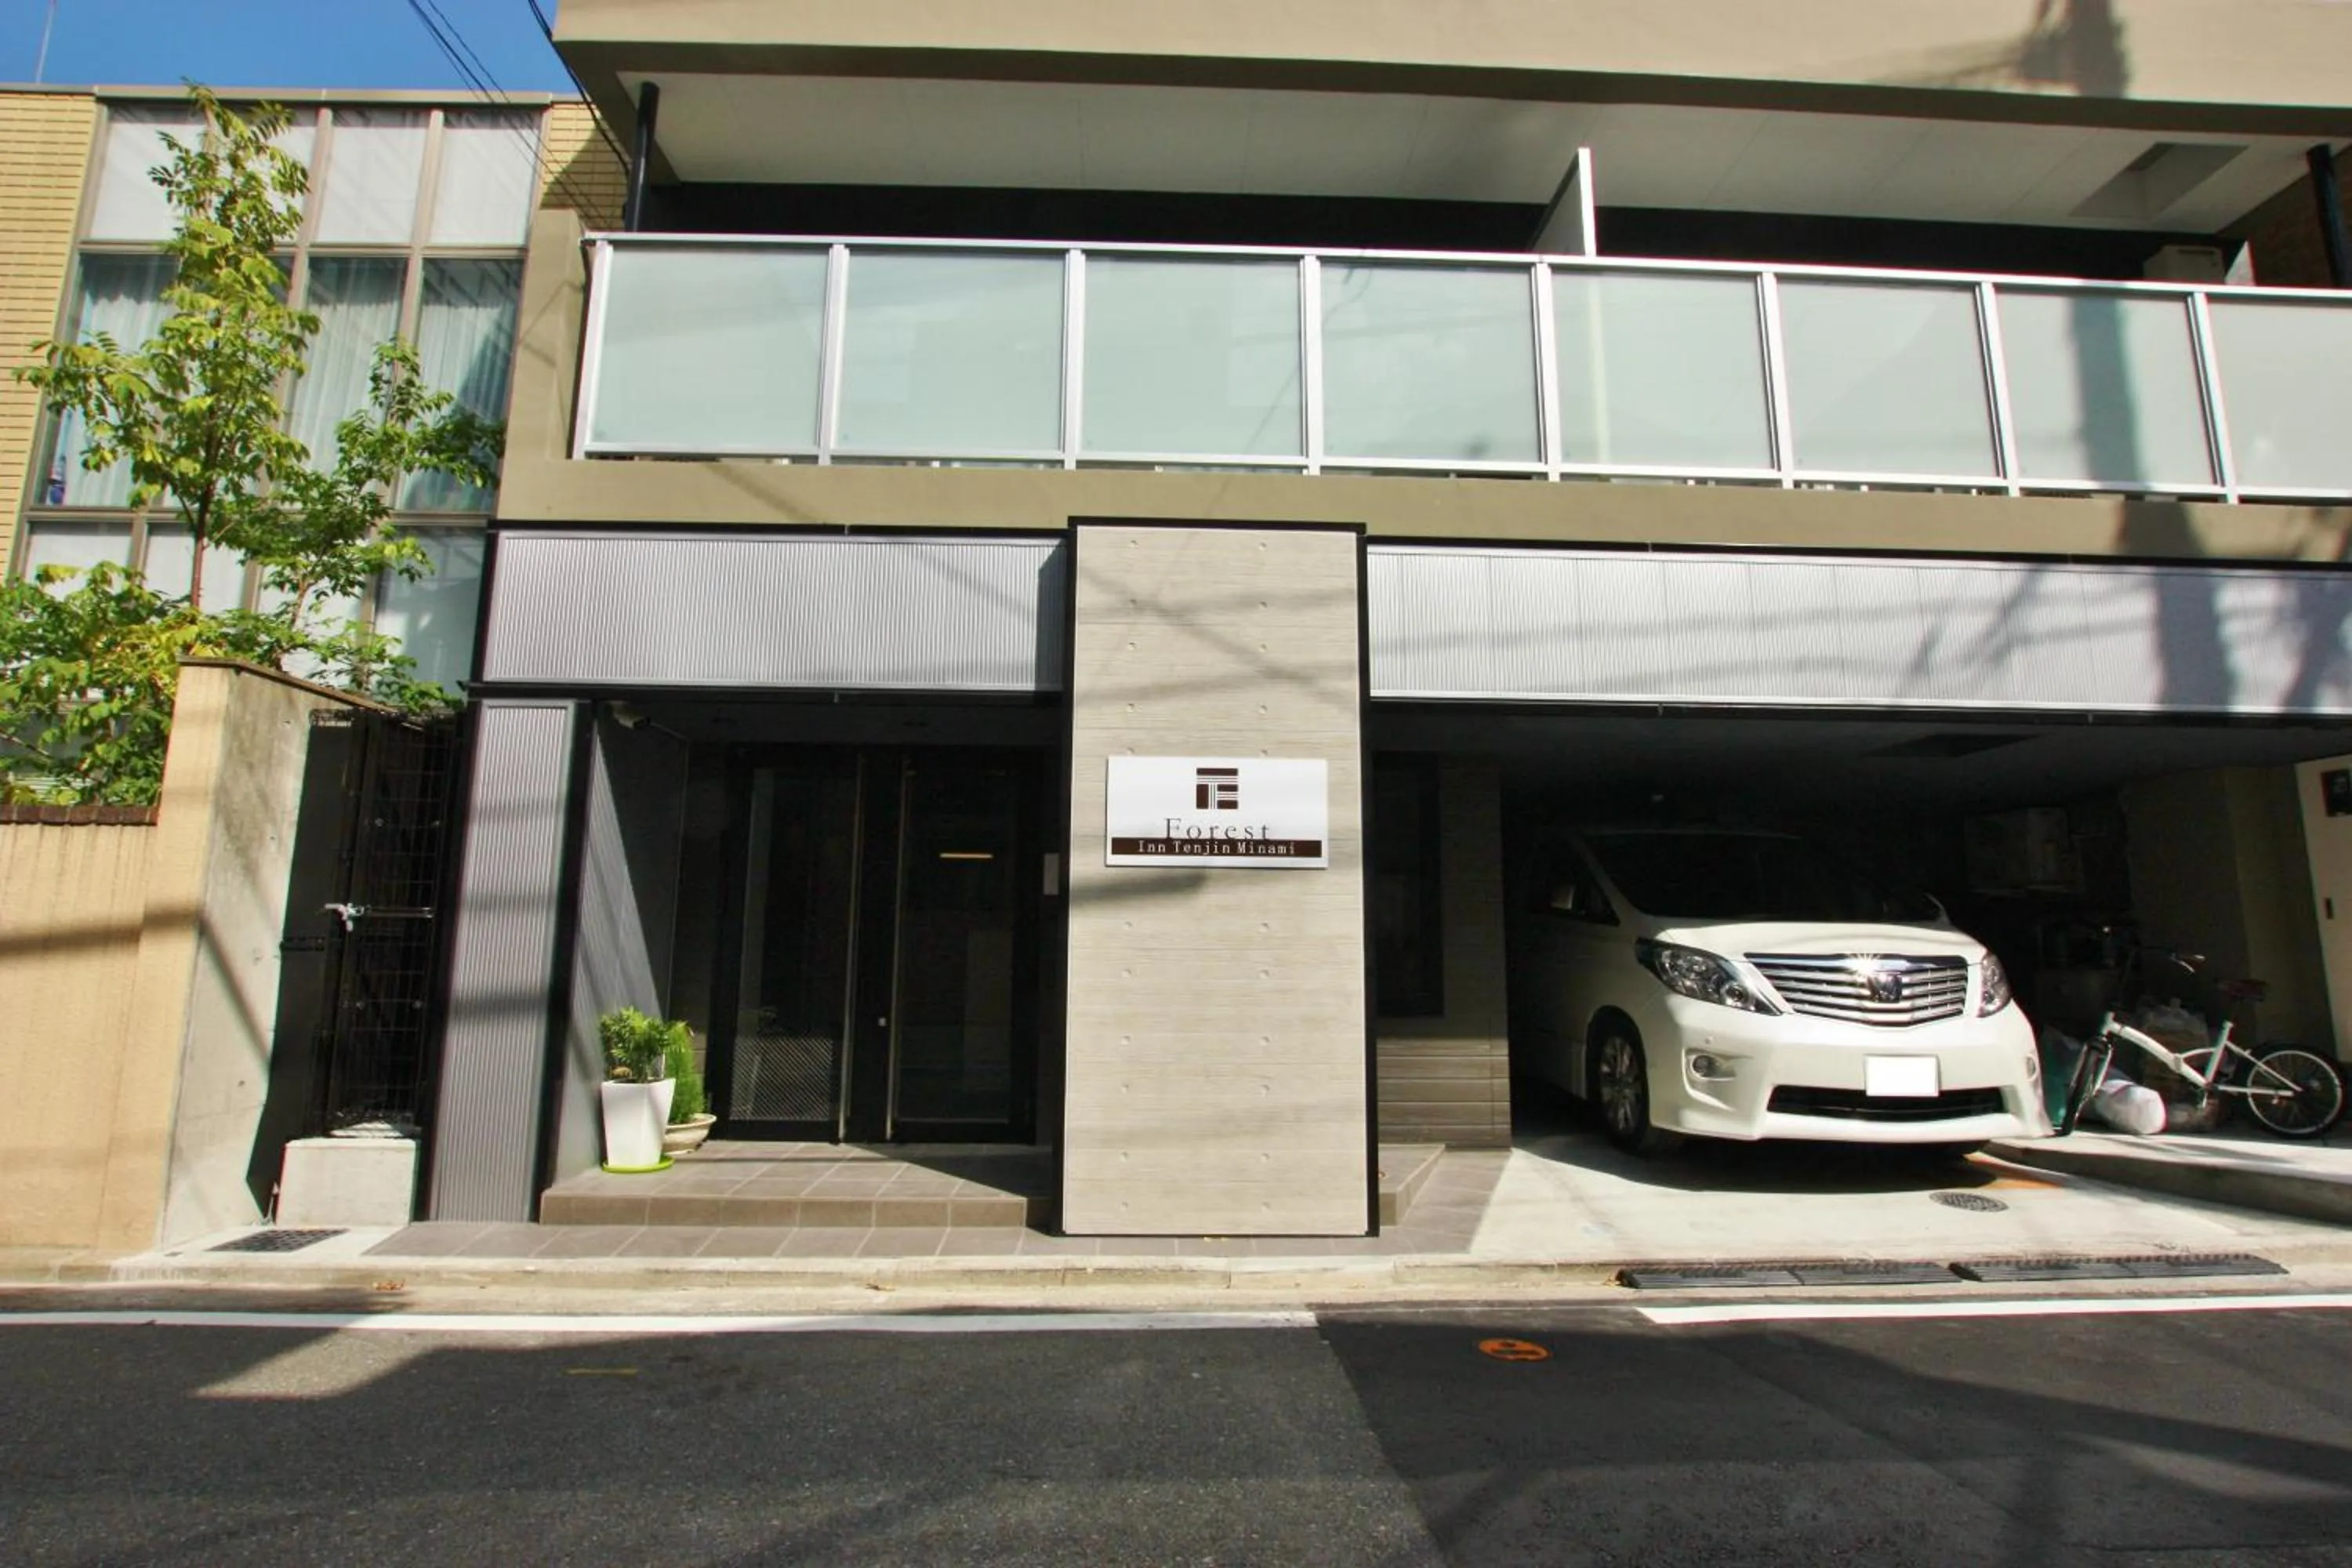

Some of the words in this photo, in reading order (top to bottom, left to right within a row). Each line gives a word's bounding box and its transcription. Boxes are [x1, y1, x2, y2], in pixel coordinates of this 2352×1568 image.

[1165, 818, 1269, 840] Forest
[1138, 840, 1167, 853] Inn
[1173, 840, 1231, 855] Tenjin
[1236, 841, 1294, 855] Minami
